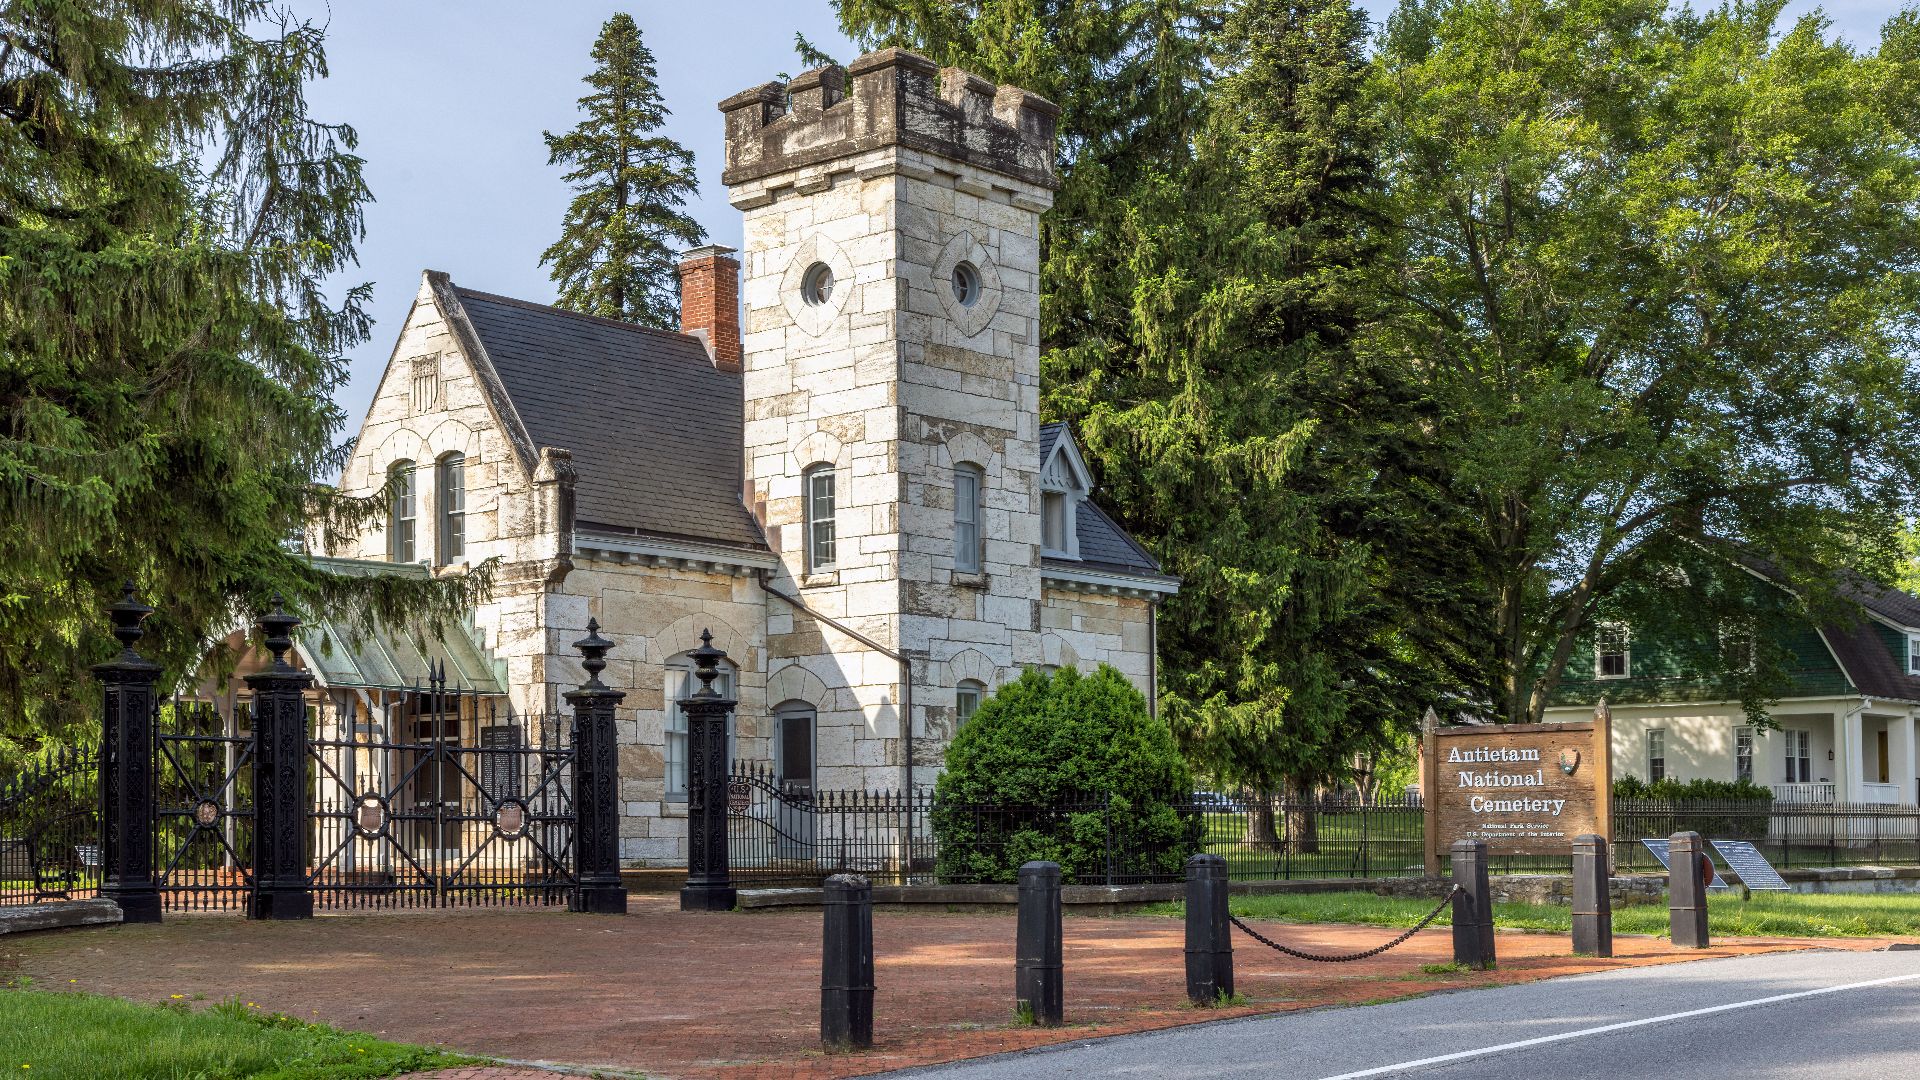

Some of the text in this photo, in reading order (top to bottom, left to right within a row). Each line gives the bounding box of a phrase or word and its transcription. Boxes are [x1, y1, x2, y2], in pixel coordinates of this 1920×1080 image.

[1447, 746, 1540, 763] Antietam
[1458, 769, 1544, 787] National
[1470, 796, 1565, 816] Cemetery
[1481, 831, 1516, 839] Department
